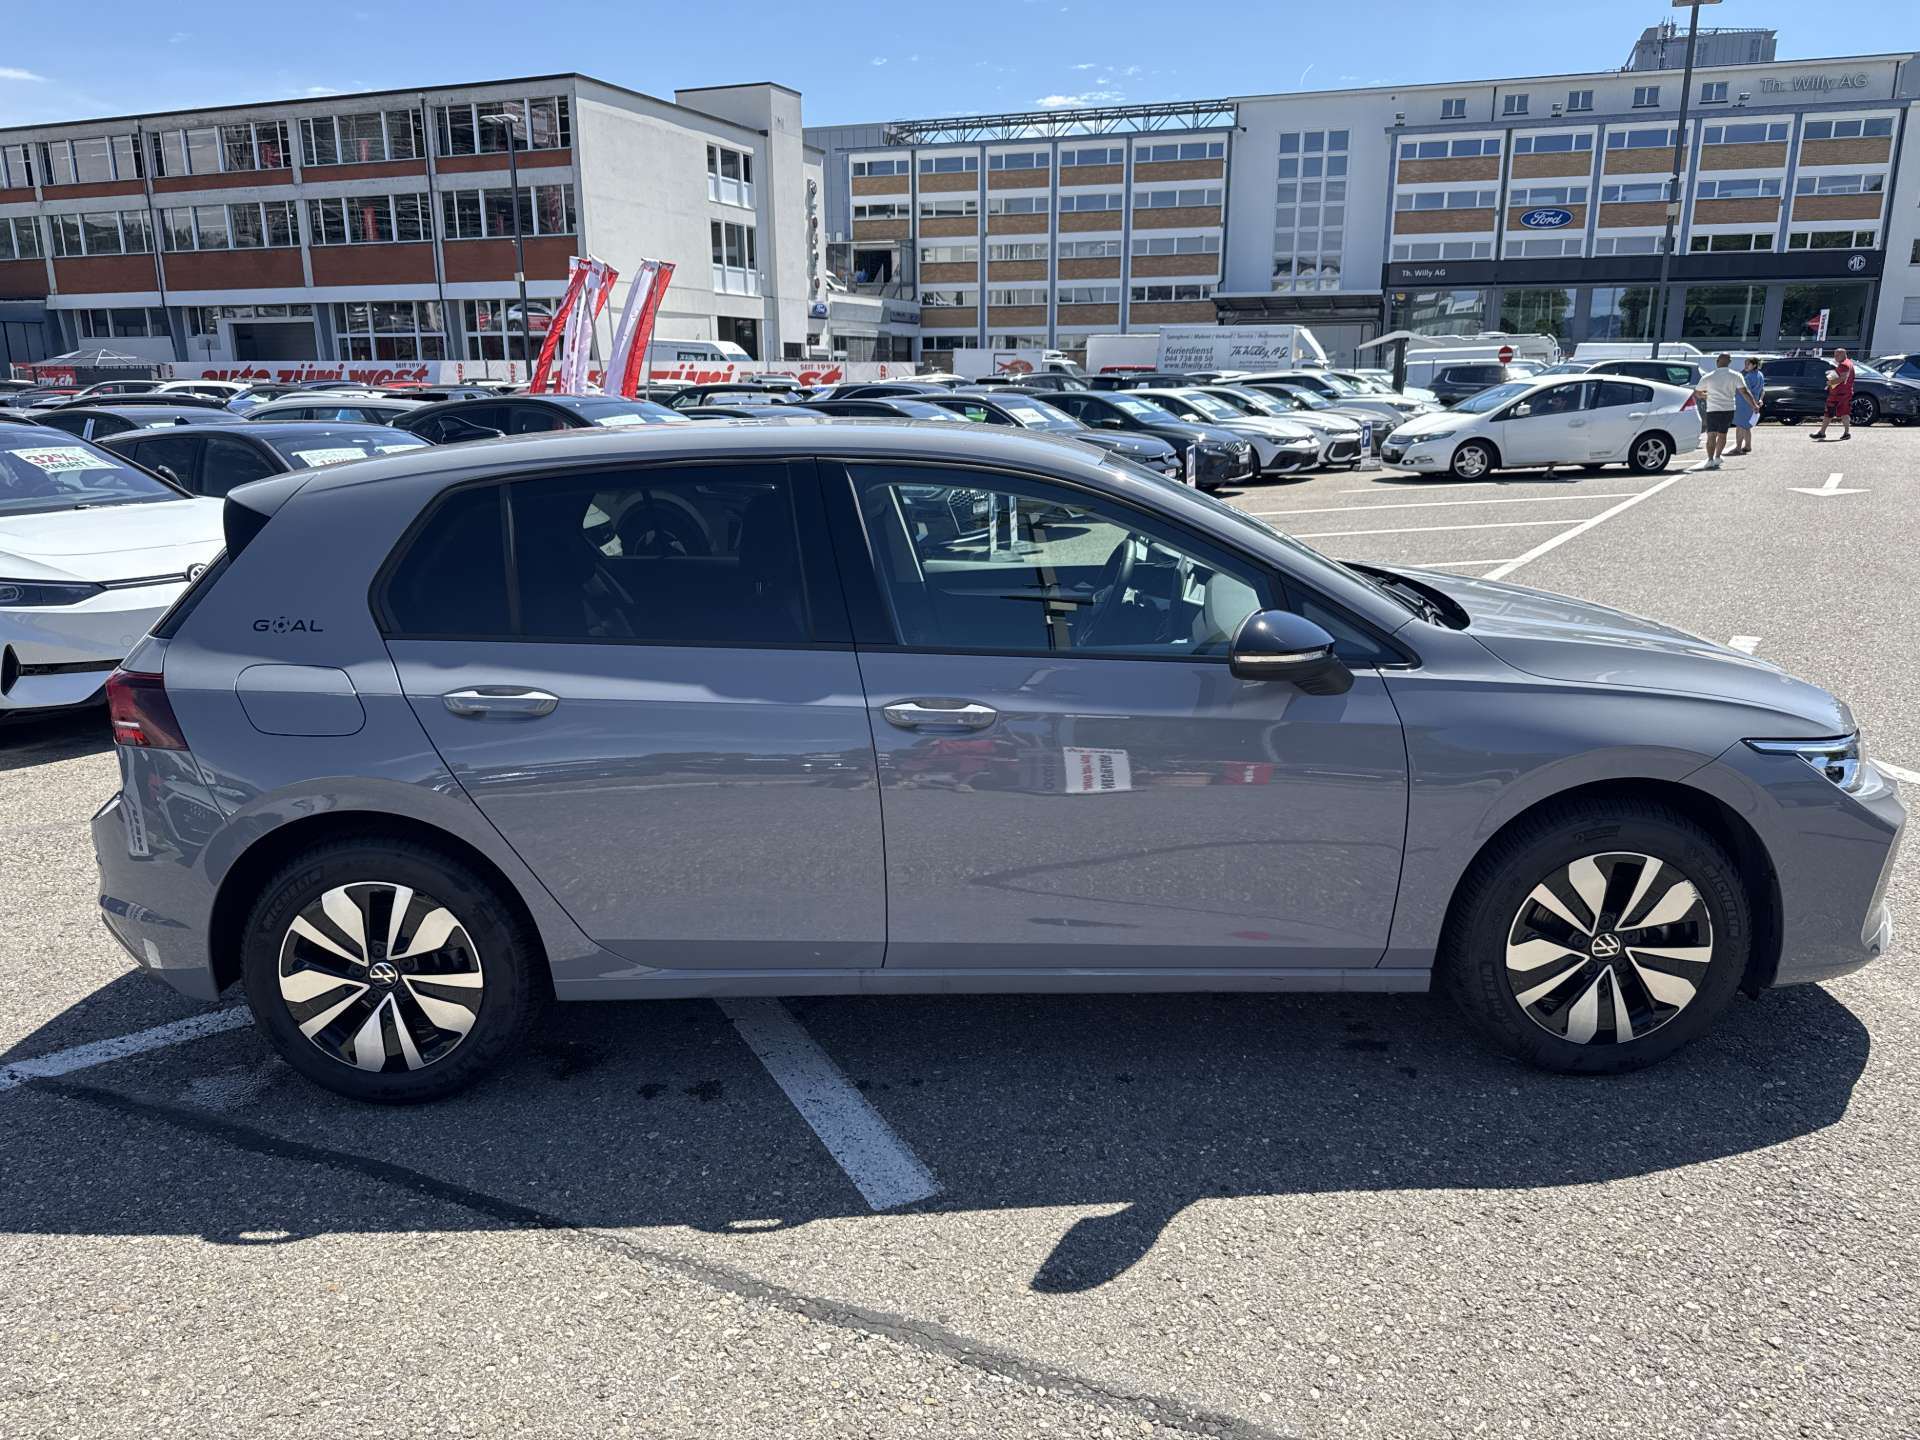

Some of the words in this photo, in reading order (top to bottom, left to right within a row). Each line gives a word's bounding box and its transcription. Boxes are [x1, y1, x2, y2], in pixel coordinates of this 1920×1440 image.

[1793, 75, 1833, 93] Willy
[1840, 73, 1869, 89] AG
[1530, 211, 1562, 225] Ford
[1848, 255, 1866, 271] MG
[1402, 269, 1412, 277] Th.
[1414, 269, 1433, 278] Willy
[1434, 269, 1446, 277] AG
[1165, 346, 1214, 355] Kurierdienst
[25, 453, 80, 465] 32%
[253, 616, 324, 633] GOAL
